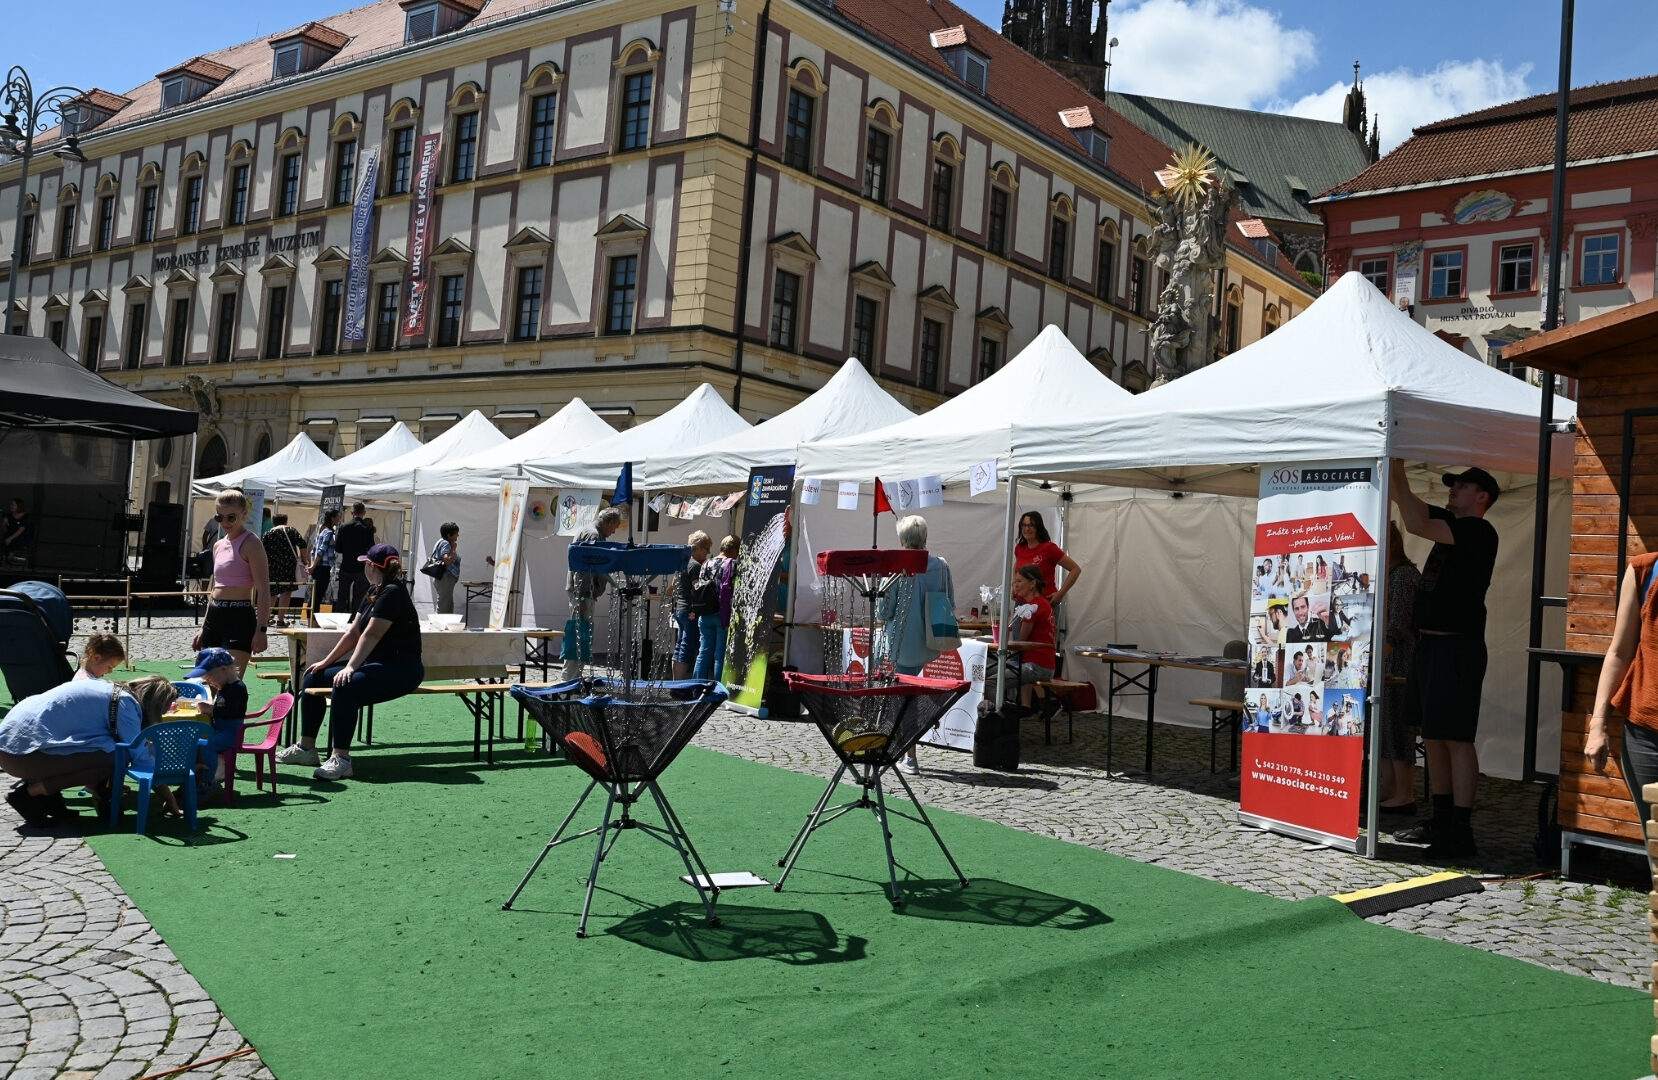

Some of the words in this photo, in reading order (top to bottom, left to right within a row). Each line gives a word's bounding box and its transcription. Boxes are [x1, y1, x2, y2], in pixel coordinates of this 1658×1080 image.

[418, 140, 433, 200] KAMENI
[417, 203, 426, 215] V
[155, 245, 209, 271] MORAVSKÉ
[216, 237, 260, 263] ZEMSKÉ
[270, 231, 320, 253] MUZEUM
[412, 217, 425, 277] UKRYTÉ
[1460, 306, 1495, 314] DIVADLO
[1272, 469, 1299, 484] SOS
[1306, 471, 1365, 480] ASOCIACE
[1266, 528, 1289, 537] Znáte
[1291, 525, 1304, 534] svá
[1306, 522, 1333, 535] práva?
[1335, 532, 1355, 541] Vám!
[1263, 761, 1274, 769] 542
[1276, 763, 1288, 772] 210
[1304, 770, 1317, 778] 542
[1318, 772, 1331, 781] 210
[1331, 775, 1345, 784] 549
[1251, 771, 1348, 799] www.asociace-sos.cz
